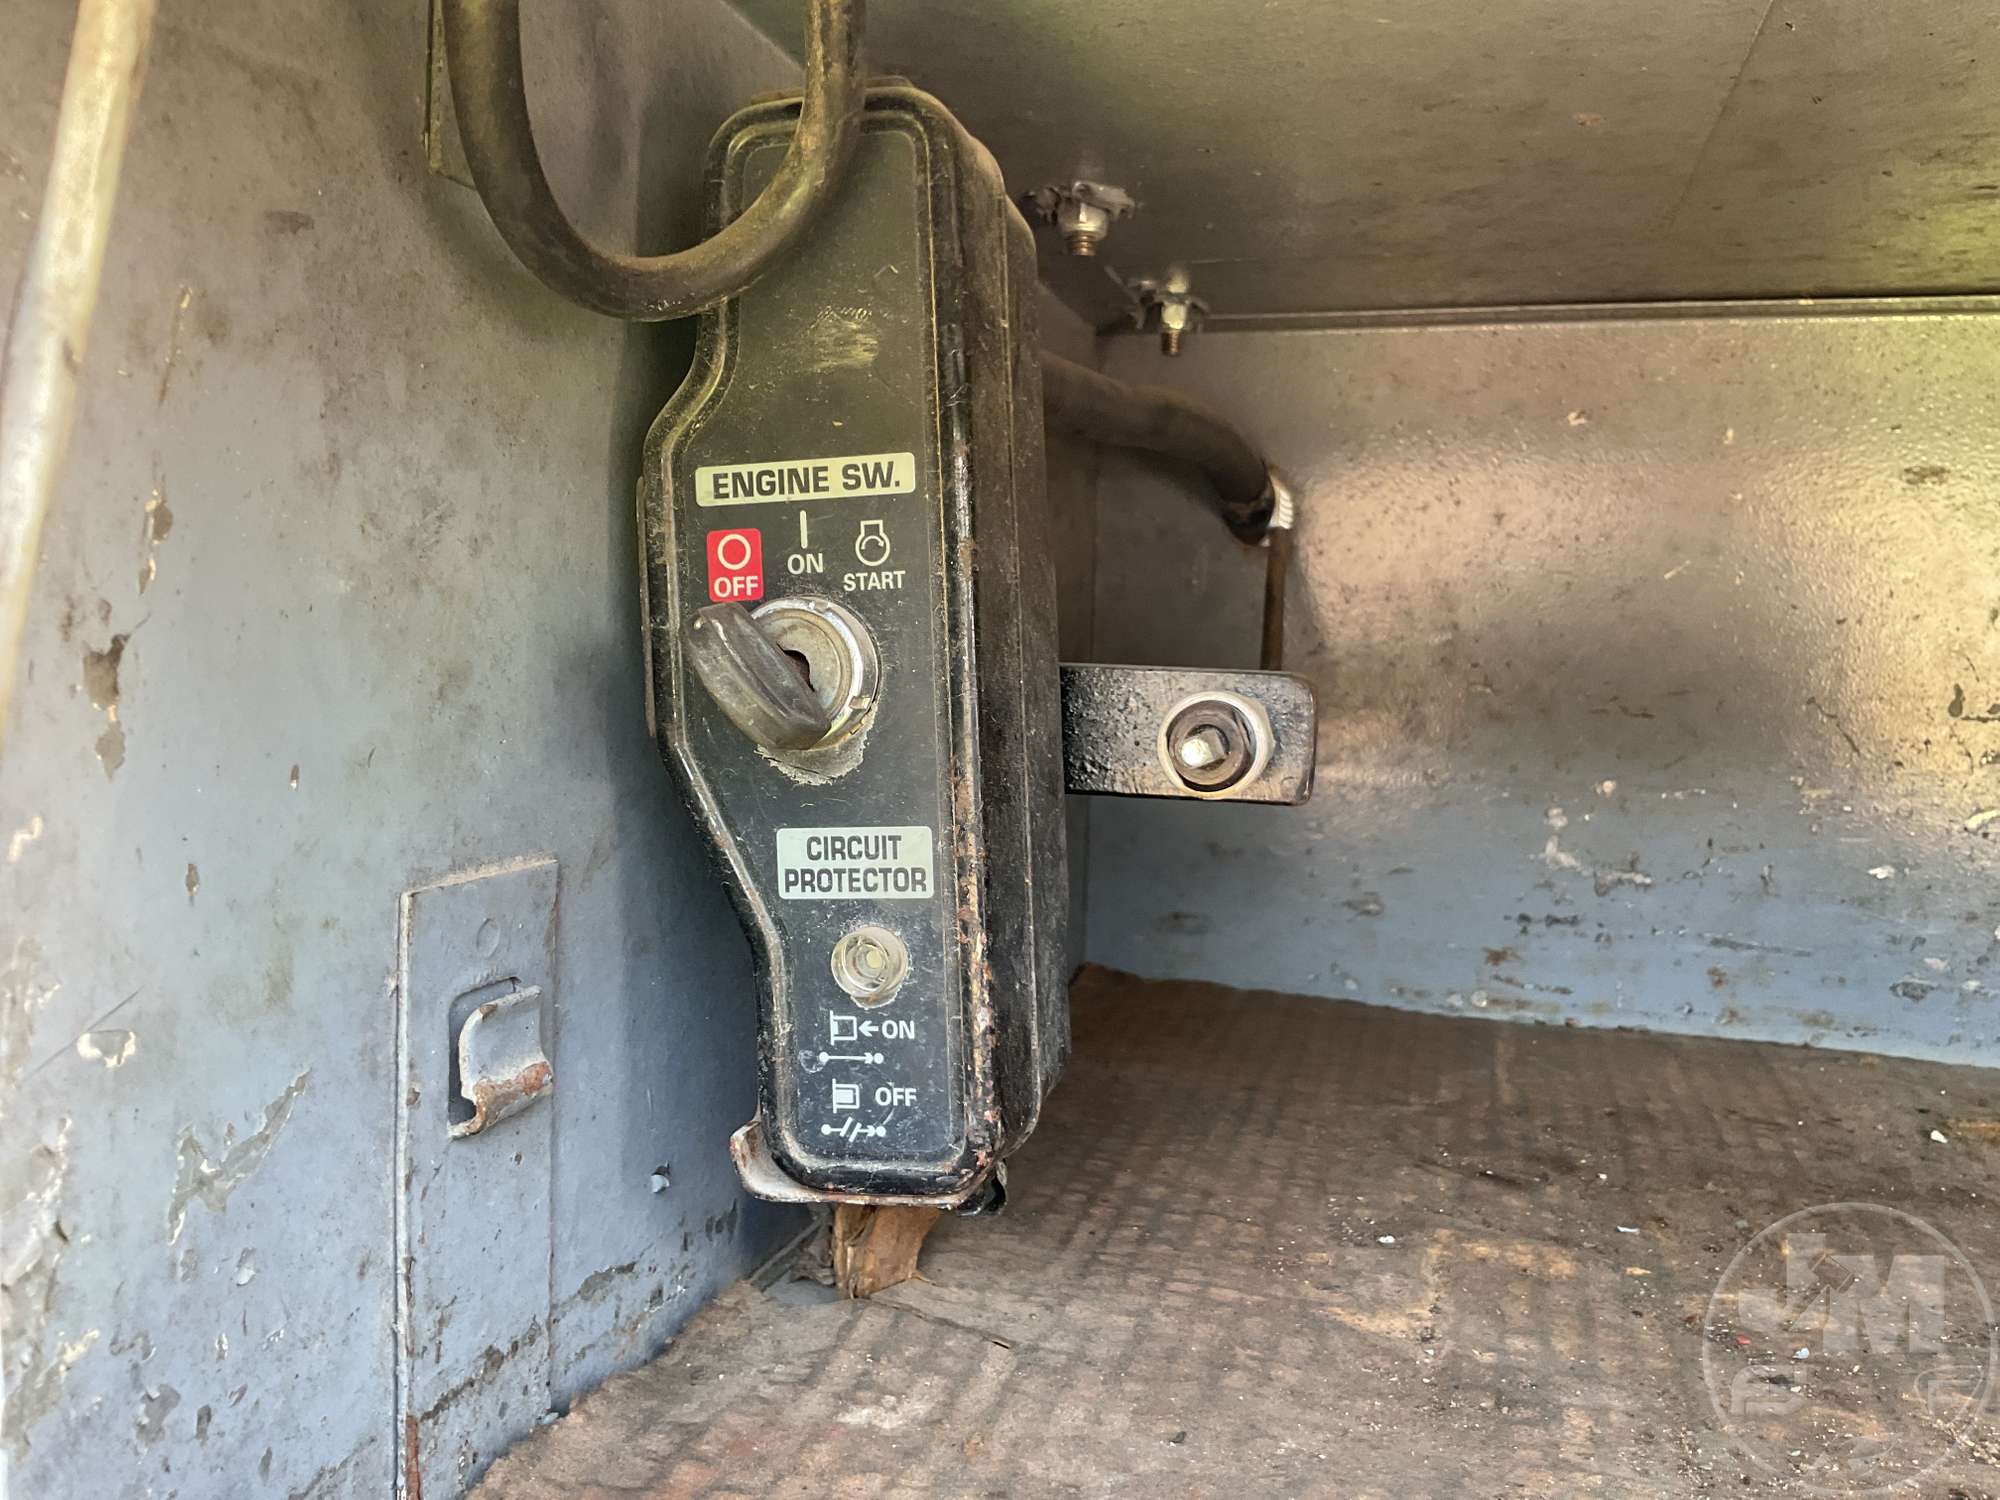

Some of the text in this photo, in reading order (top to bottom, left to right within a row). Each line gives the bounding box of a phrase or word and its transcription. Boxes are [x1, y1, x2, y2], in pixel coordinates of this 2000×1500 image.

[713, 461, 901, 500] ENGINE SW.
[787, 553, 824, 575] ON
[713, 575, 759, 598] OFF
[843, 570, 906, 592] START
[806, 835, 902, 861] CIRCUIT
[784, 867, 927, 893] PROTECTOR
[881, 1020, 916, 1040] ON
[875, 1088, 917, 1107] OFF
